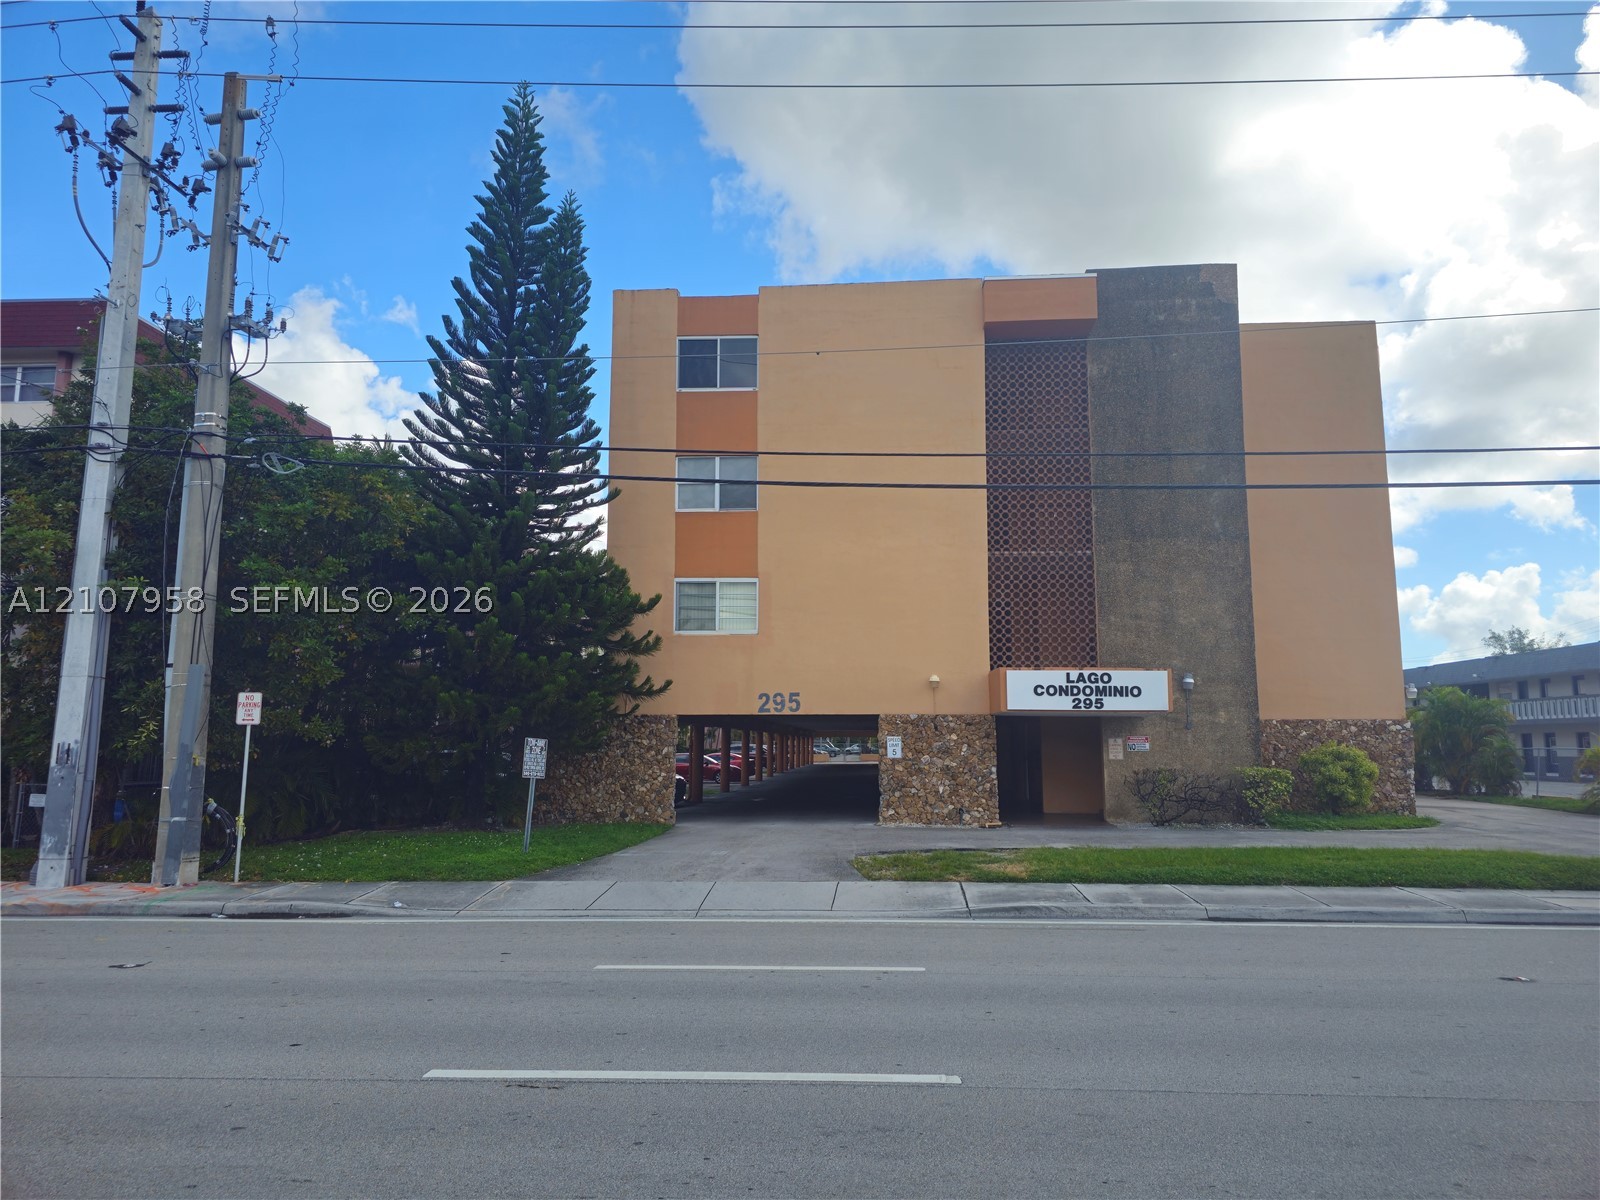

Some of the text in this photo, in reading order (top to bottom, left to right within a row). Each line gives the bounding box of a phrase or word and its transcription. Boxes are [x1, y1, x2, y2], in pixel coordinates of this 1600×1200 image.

[1066, 672, 1112, 684] LAGO
[1033, 684, 1142, 698] CONDOMINIO
[757, 691, 801, 713] 295
[1071, 698, 1105, 710] 295
